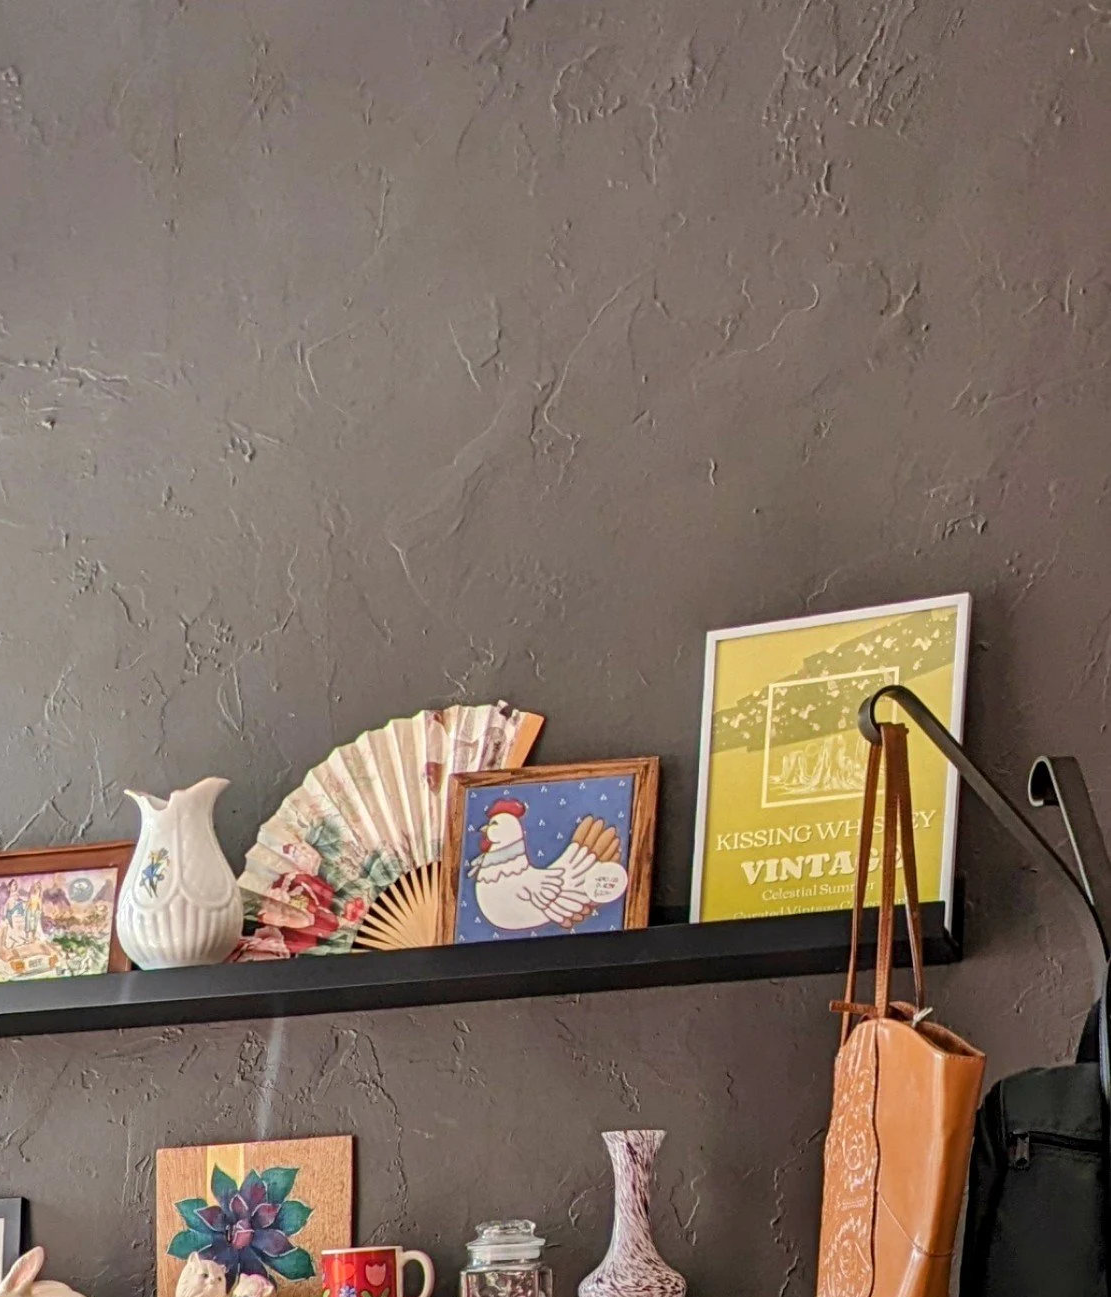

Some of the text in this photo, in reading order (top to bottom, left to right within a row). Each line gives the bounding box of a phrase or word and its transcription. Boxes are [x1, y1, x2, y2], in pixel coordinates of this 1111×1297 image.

[716, 809, 936, 851] KISSING WHSEY
[762, 884, 817, 901] Celestial
